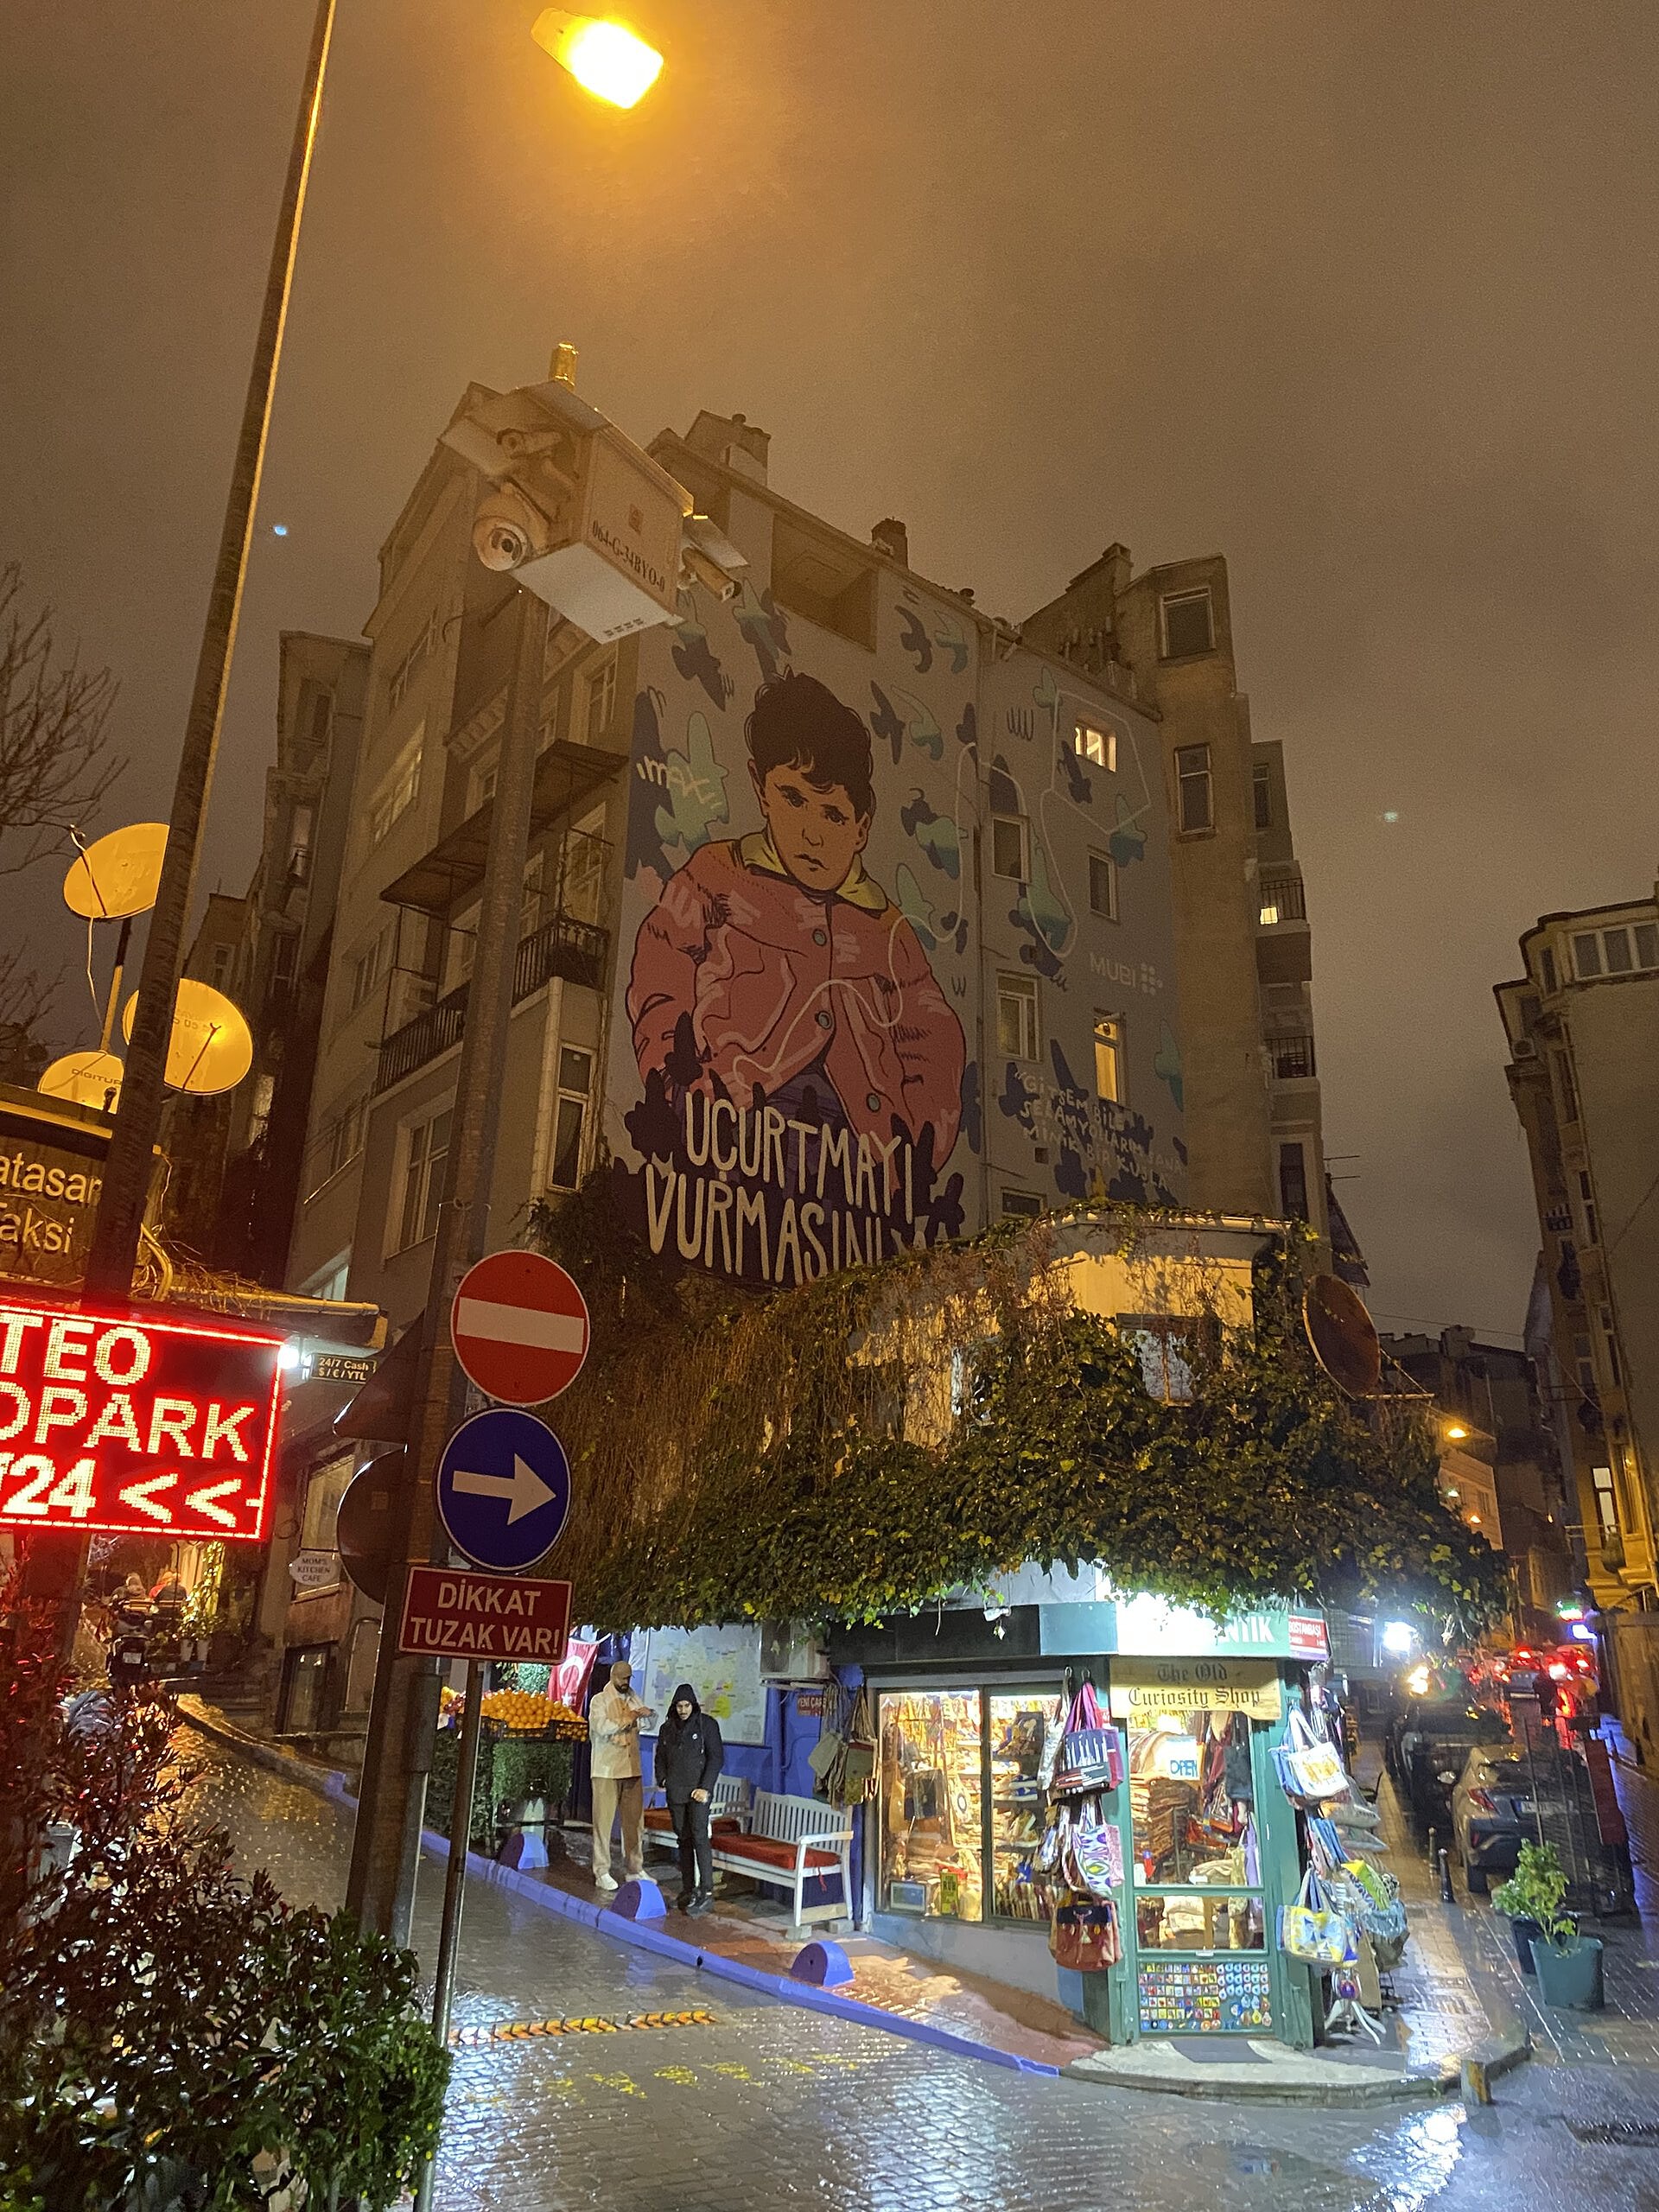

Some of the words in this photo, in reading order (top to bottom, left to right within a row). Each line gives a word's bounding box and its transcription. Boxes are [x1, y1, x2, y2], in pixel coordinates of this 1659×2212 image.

[1090, 952, 1137, 988] MUBI
[685, 1091, 913, 1224] UÇURTMAYI
[0, 1202, 74, 1254] aksi
[0, 1313, 151, 1386] TEO
[318, 1357, 341, 1368] 24/7
[344, 1360, 369, 1371] Cash
[437, 1578, 541, 1617] DİKKAT
[410, 1617, 496, 1650] TUZAK
[502, 1624, 561, 1655] VAR!
[1157, 1662, 1189, 1682] The
[1195, 1662, 1228, 1682] Old
[1128, 1687, 1209, 1709] Curiosity
[1215, 1687, 1261, 1708] Shop
[1170, 1759, 1198, 1778] OPEN
